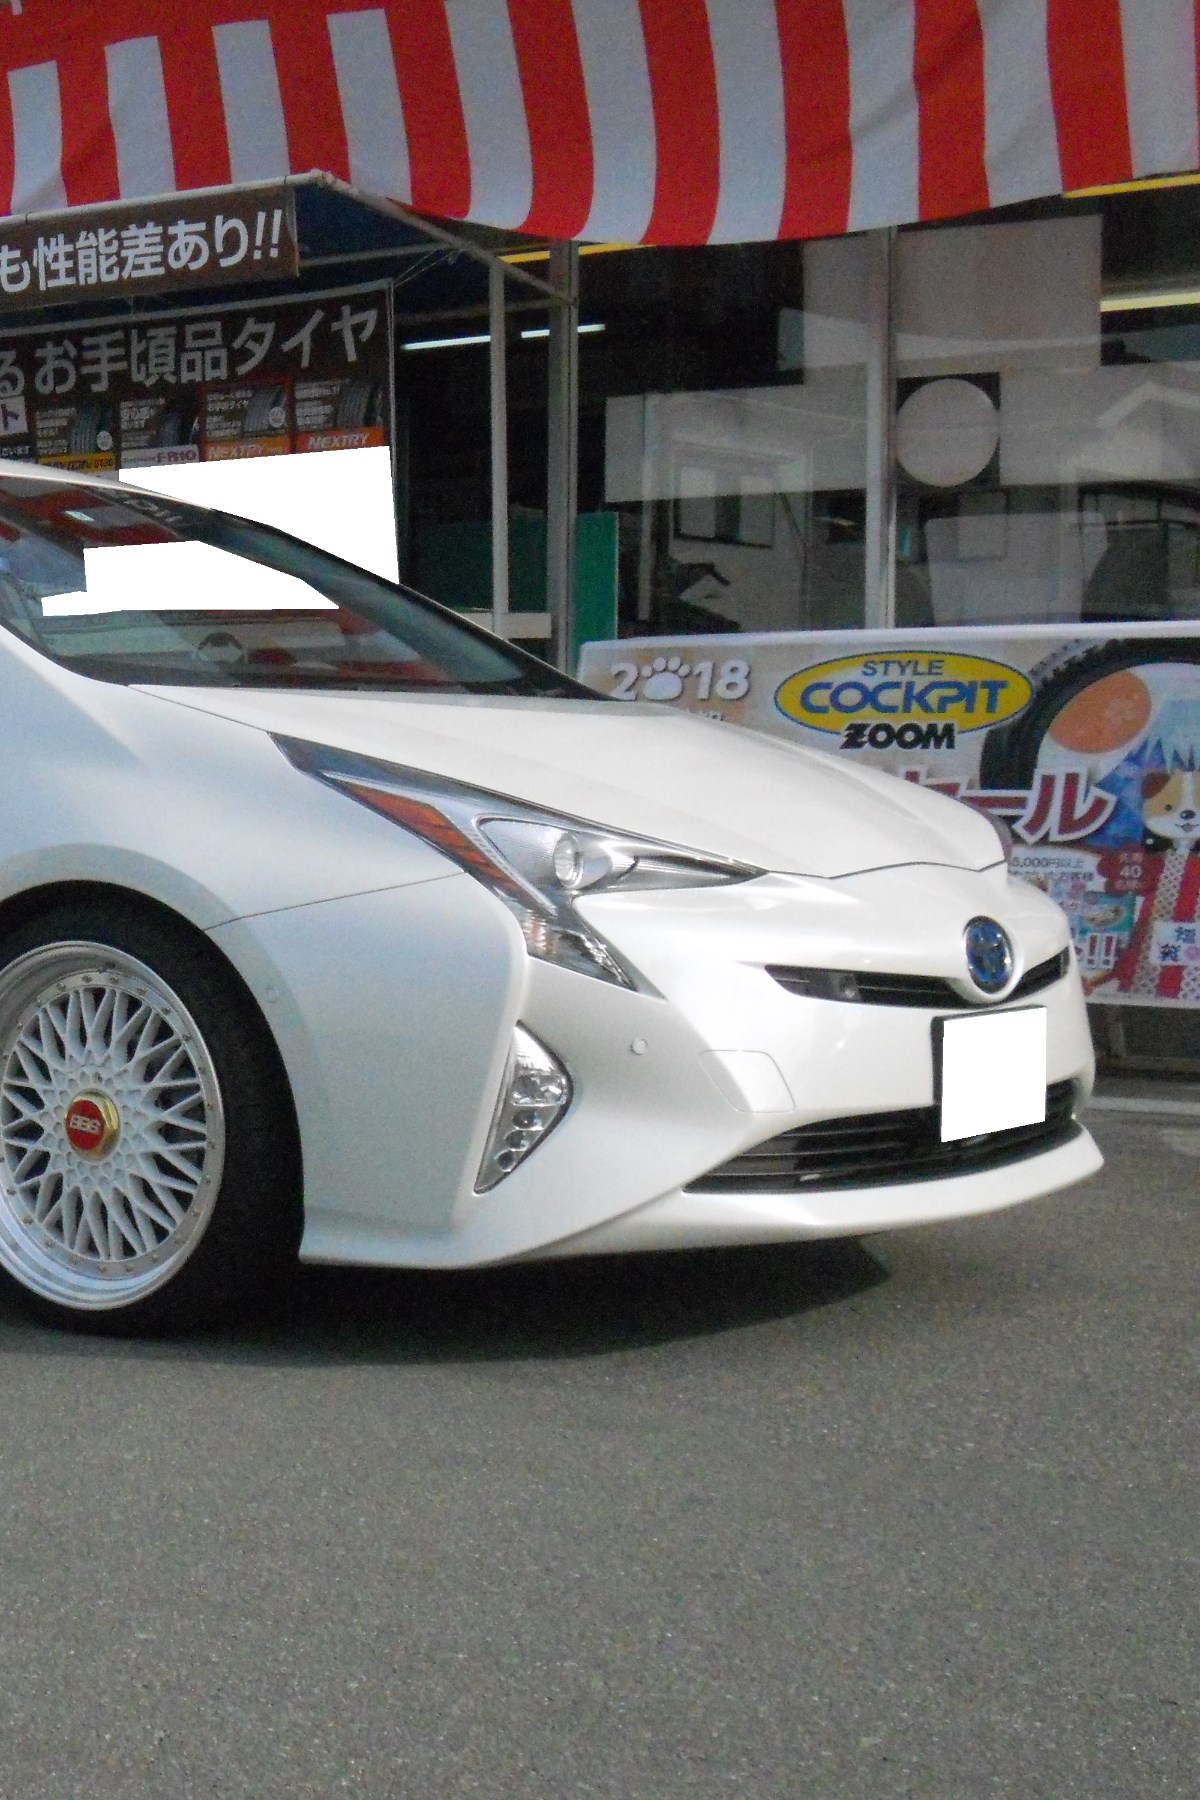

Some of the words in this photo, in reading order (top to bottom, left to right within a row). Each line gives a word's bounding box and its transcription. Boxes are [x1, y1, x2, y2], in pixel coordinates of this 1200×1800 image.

[862, 660, 945, 676] STYLE
[801, 681, 1008, 714] COCKPIT
[840, 722, 955, 749] ZOOM
[69, 1113, 102, 1135] BBS
